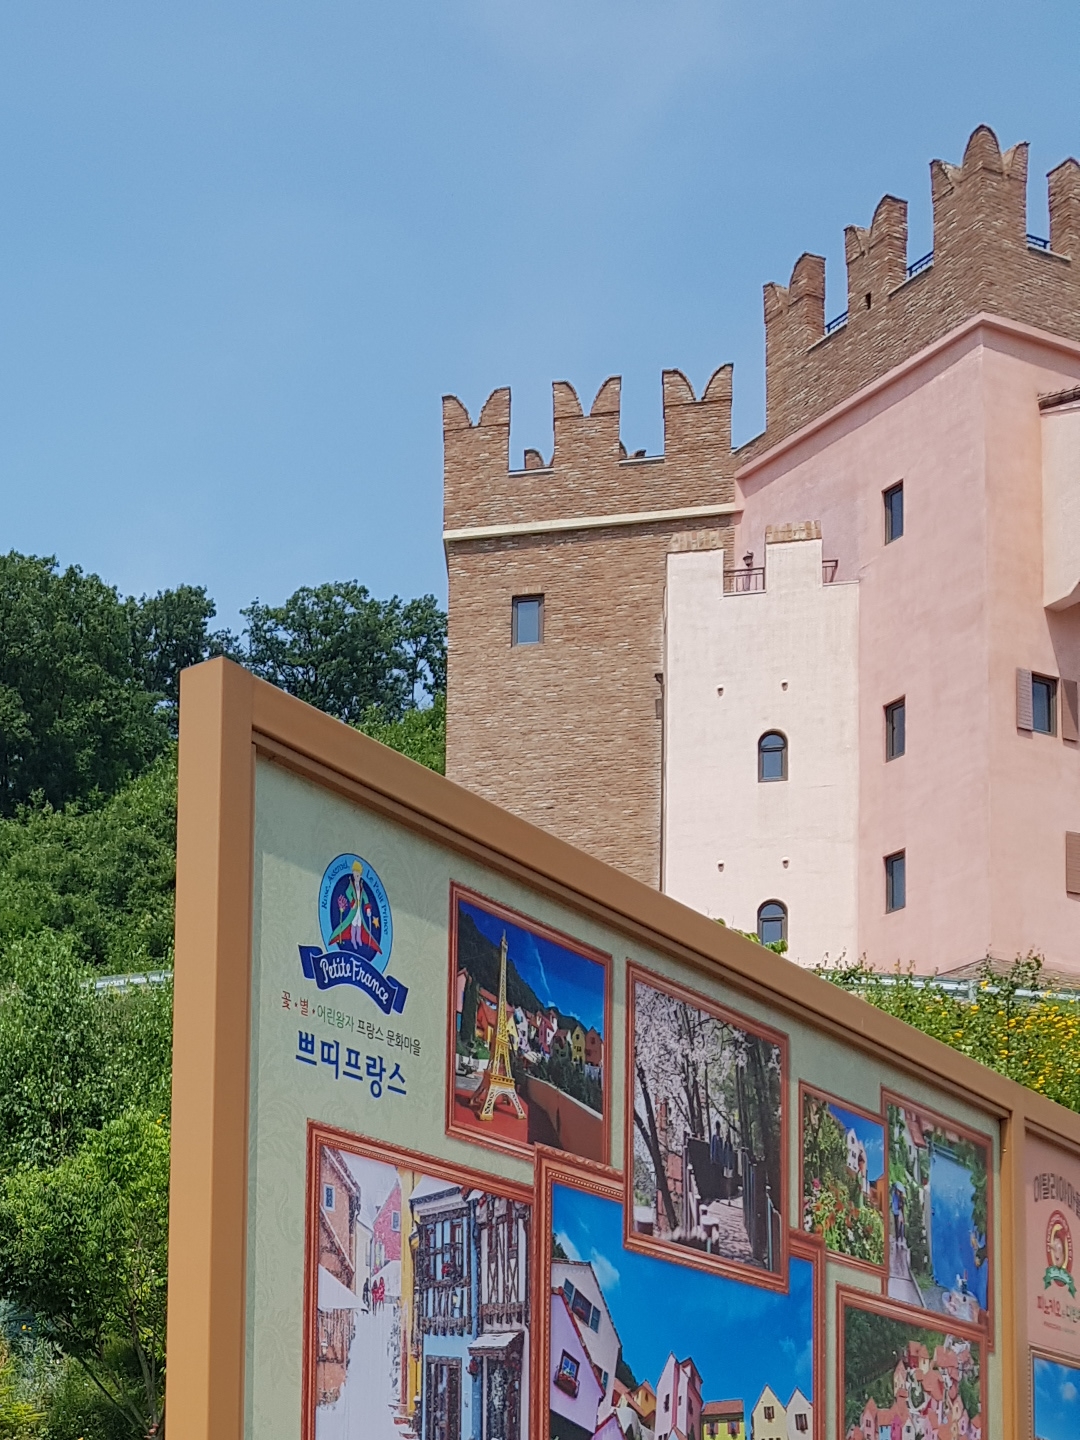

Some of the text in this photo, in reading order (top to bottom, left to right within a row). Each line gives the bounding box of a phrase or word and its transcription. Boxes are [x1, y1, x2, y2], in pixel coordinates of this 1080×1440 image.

[373, 881, 384, 902] Petit
[381, 904, 389, 935] Prince
[320, 957, 390, 1005] Petite France
[317, 1004, 355, 1033] 어린왕자
[356, 1019, 385, 1042] 프랑스
[386, 1029, 422, 1057] 문화마을
[295, 1030, 408, 1099] 쁘띠프랑스
